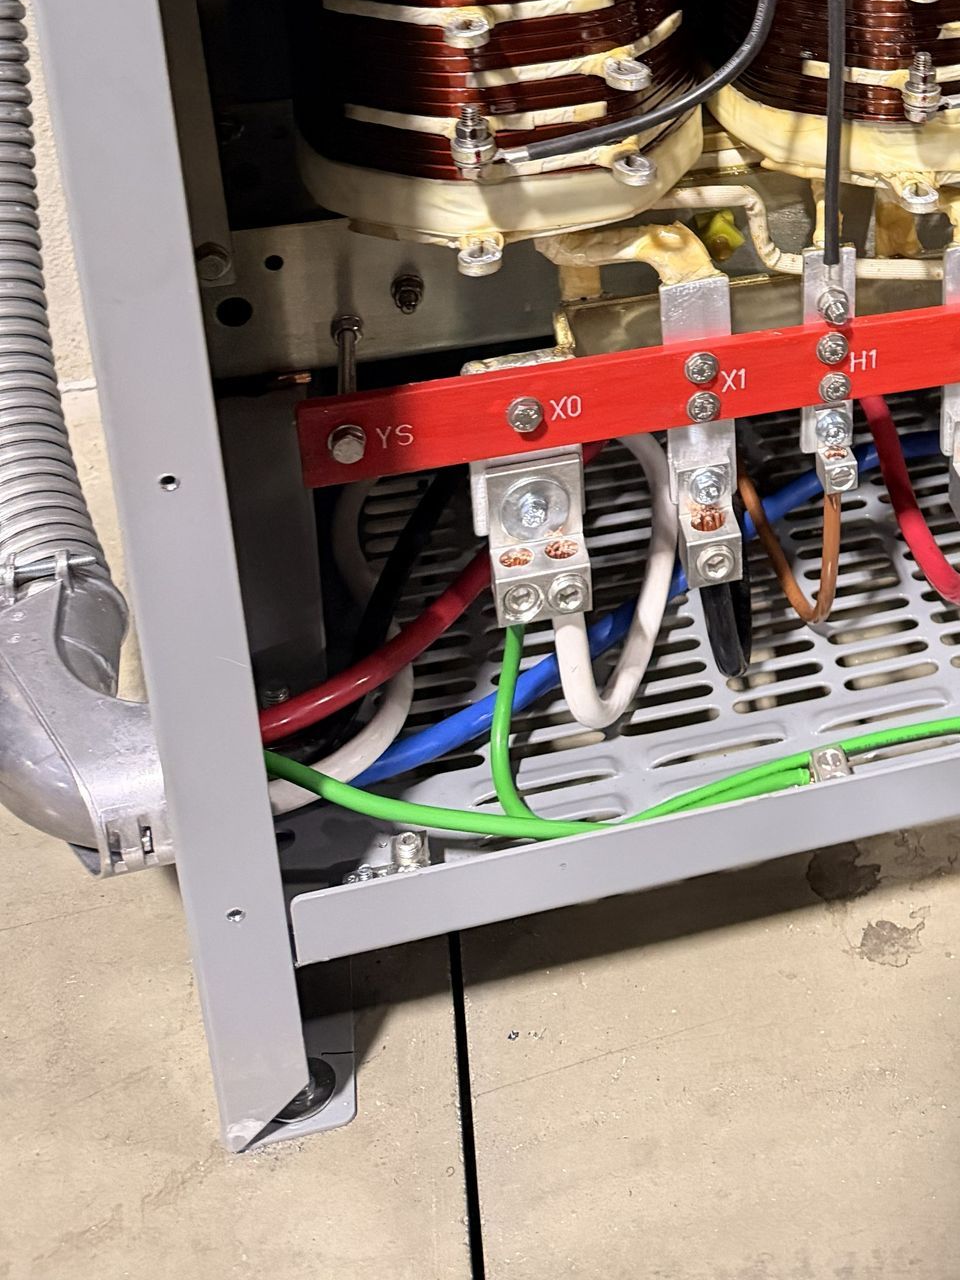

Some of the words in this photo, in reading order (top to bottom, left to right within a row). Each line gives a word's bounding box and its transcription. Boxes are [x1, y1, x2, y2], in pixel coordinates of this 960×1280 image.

[849, 349, 877, 373] H1
[720, 368, 747, 394] X1
[376, 424, 414, 450] YS
